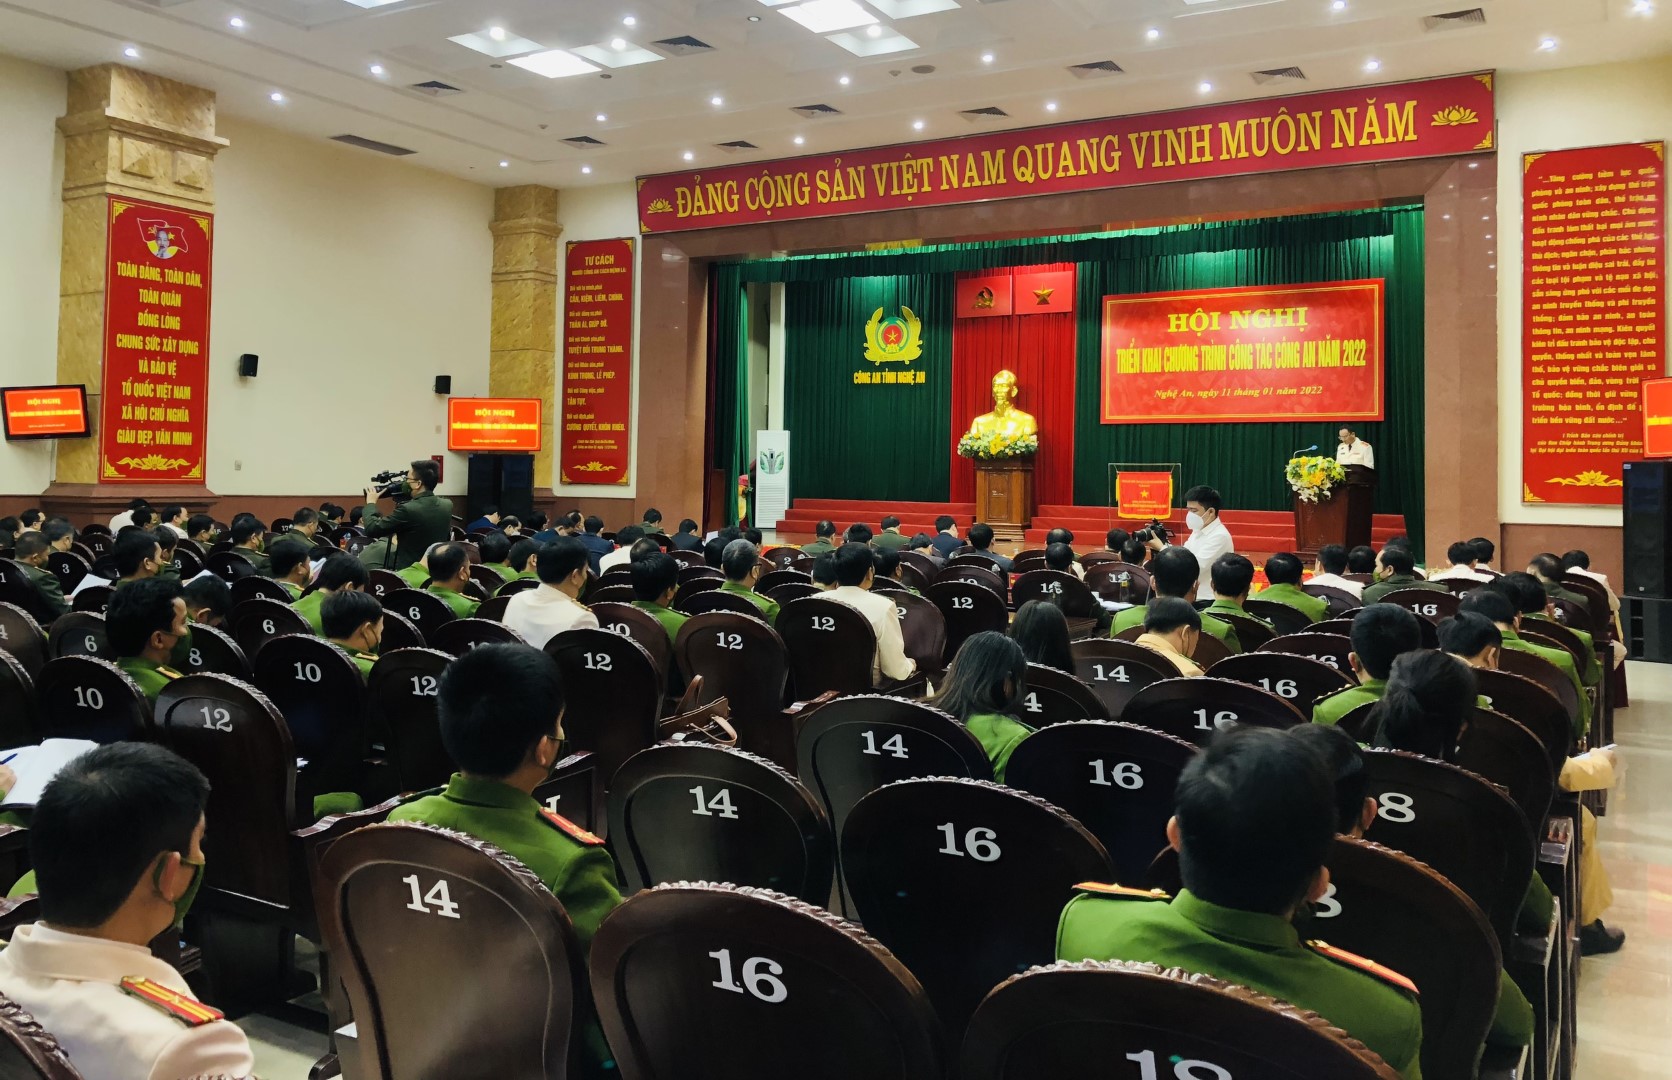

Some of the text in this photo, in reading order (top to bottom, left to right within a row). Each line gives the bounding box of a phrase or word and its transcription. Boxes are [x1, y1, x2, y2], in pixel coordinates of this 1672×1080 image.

[676, 98, 1418, 217] ĐẢNG CỘNG SẢN VIỆT NAM QUANG VINH MUÔN NĂM
[585, 254, 614, 265] TƯ CÁCH
[117, 262, 202, 288] TOÀN ĐẢNG, TOÀN DÂN,
[139, 288, 181, 307] TOÀN QUÂN
[138, 310, 180, 330] ĐỒNG LÒNG
[1168, 307, 1308, 336] HỘI NGHỊ
[116, 332, 198, 357] CHUNG SỨC XÂY DỰNG
[1116, 334, 1366, 374] TRIỂN KHAI CHƯƠNG TRÌNH CÔNG TÁC CÔNG AN NĂM 2022
[139, 356, 176, 376] VÀ BẢO VỆ
[122, 376, 190, 400] TỔ QUỐC VIỆT NAM
[1154, 386, 1322, 400] Nghệ An, ngày 11 tháng 01 năm 2022
[122, 404, 189, 423] XÃ HỘI CHỦ NGHĨA
[117, 428, 192, 448] GIÀU ĐẸP, VĂN MINH
[62, 564, 70, 573] 3
[227, 565, 233, 574] 1
[375, 585, 385, 596] 2
[409, 606, 420, 620] 6
[952, 597, 974, 609] 12
[1412, 604, 1437, 616] 16
[262, 619, 275, 634] 6
[811, 616, 835, 631] 12
[84, 635, 97, 652] 6
[716, 632, 743, 650] 12
[188, 648, 202, 666] 8
[584, 652, 612, 672] 12
[294, 662, 321, 682] 10
[1092, 664, 1130, 683] 14
[411, 676, 438, 696] 12
[1258, 678, 1298, 698] 16
[74, 686, 103, 709] 10
[1024, 692, 1042, 712] 4
[201, 707, 233, 732] 12
[861, 731, 909, 759] 14
[1088, 759, 1144, 790] 16
[689, 786, 739, 819] 14
[1378, 792, 1416, 822] 8
[937, 822, 1001, 862] 16
[402, 874, 461, 919] 14
[708, 948, 787, 1004] 16
